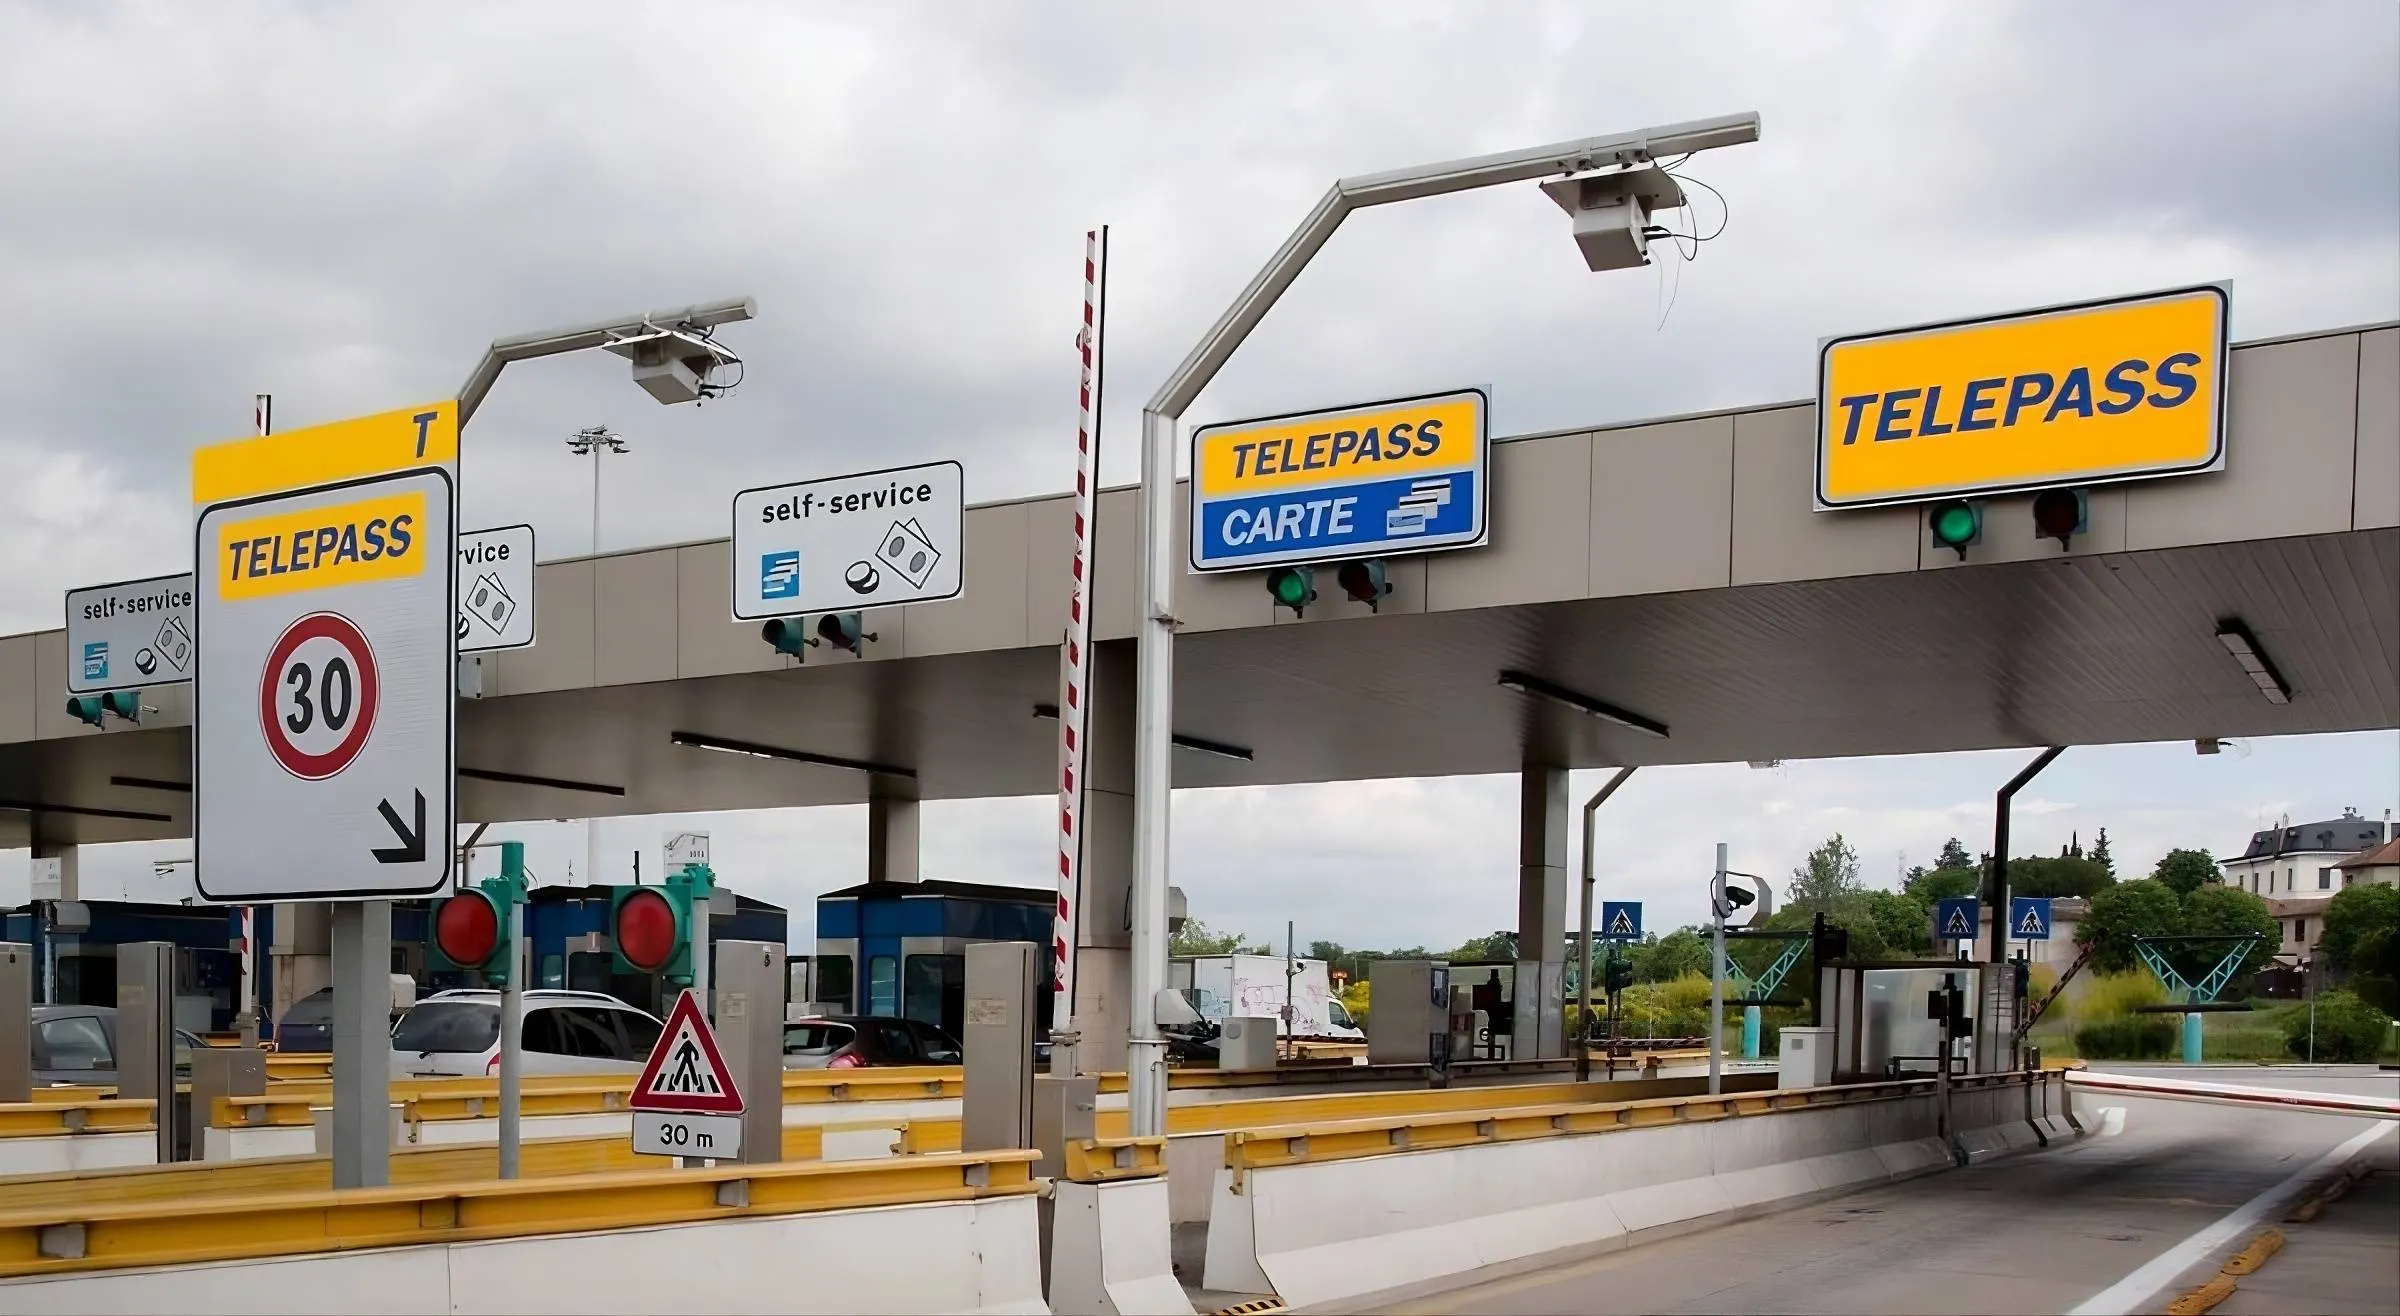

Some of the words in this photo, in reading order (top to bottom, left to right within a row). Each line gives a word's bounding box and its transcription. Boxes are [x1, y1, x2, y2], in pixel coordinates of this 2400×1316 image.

[1839, 352, 2201, 446] TELEPASS
[413, 411, 438, 458] T
[1232, 419, 1443, 479] TELEPASS
[762, 482, 932, 523] self-service
[1222, 496, 1358, 546] CARTE
[229, 514, 413, 581] TELEPASS
[286, 656, 352, 734] 30
[660, 1123, 689, 1146] 30
[696, 1133, 714, 1148] m
